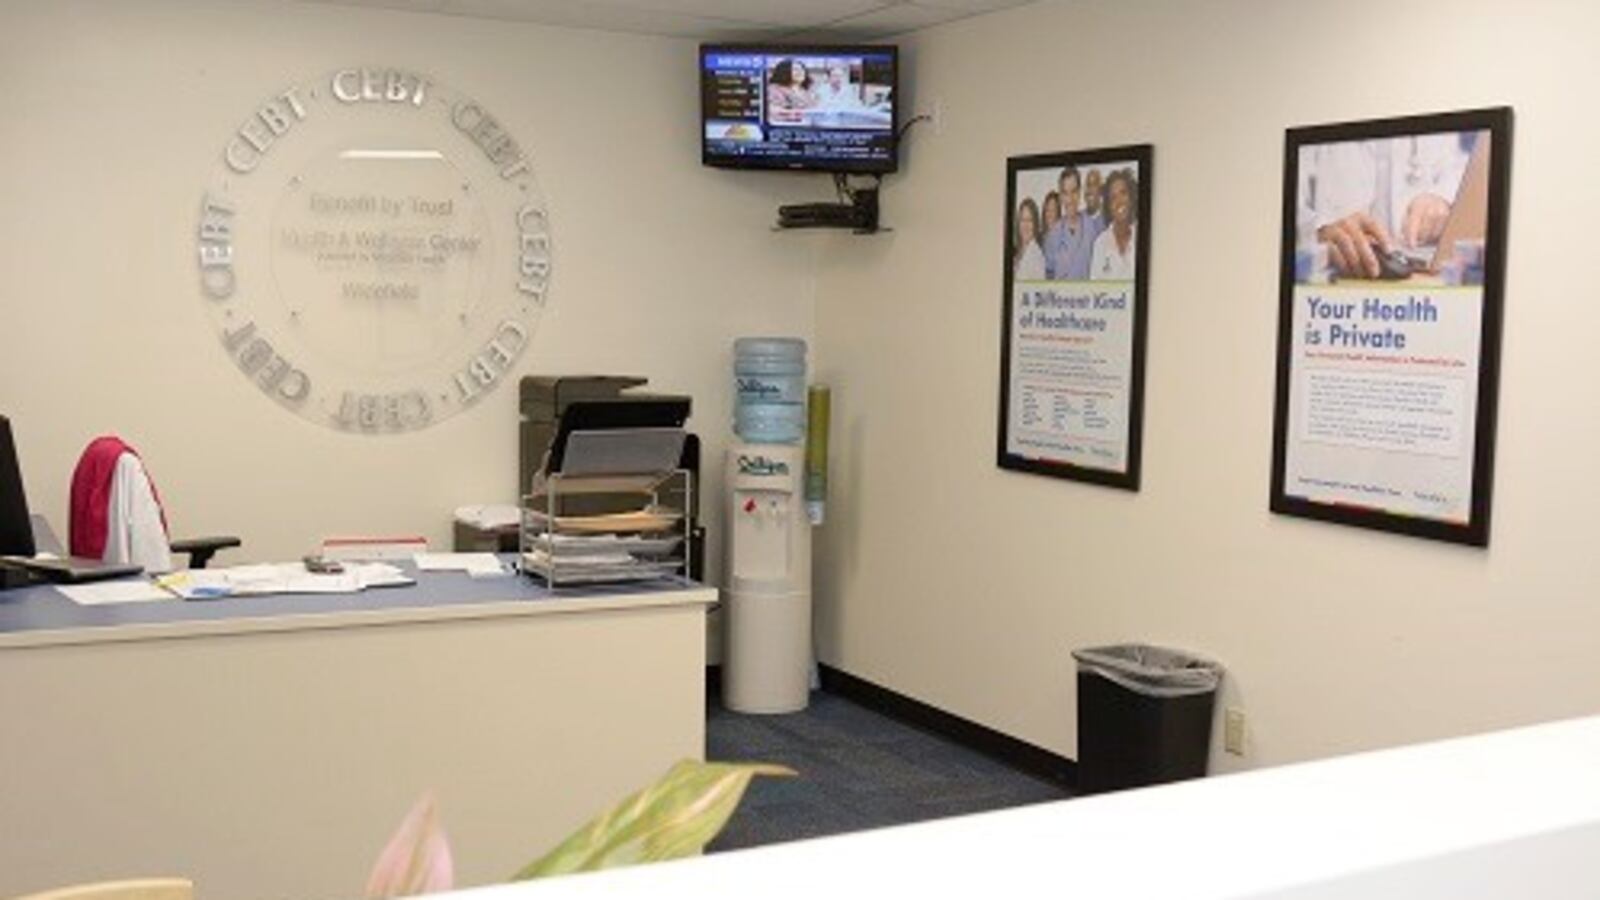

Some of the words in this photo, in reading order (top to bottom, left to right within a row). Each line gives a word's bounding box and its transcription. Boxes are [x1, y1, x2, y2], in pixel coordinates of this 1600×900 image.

[331, 69, 430, 106] CEBT
[225, 87, 306, 174] CEBT
[452, 101, 529, 181] CEBT
[380, 195, 404, 218] by
[407, 196, 454, 216] Trust
[200, 195, 236, 300] CEBT
[517, 205, 550, 302] CEBT
[1034, 289, 1090, 309] Different
[1093, 291, 1127, 310] Kind
[1307, 296, 1355, 320] Your
[1362, 295, 1438, 322] Health
[1019, 310, 1033, 329] of
[1035, 311, 1106, 332] Healthcare
[1304, 323, 1321, 345] is
[1329, 324, 1406, 349] Private
[224, 319, 311, 402] CEBT
[455, 320, 528, 401] CEBT
[336, 392, 433, 428] CEBT
